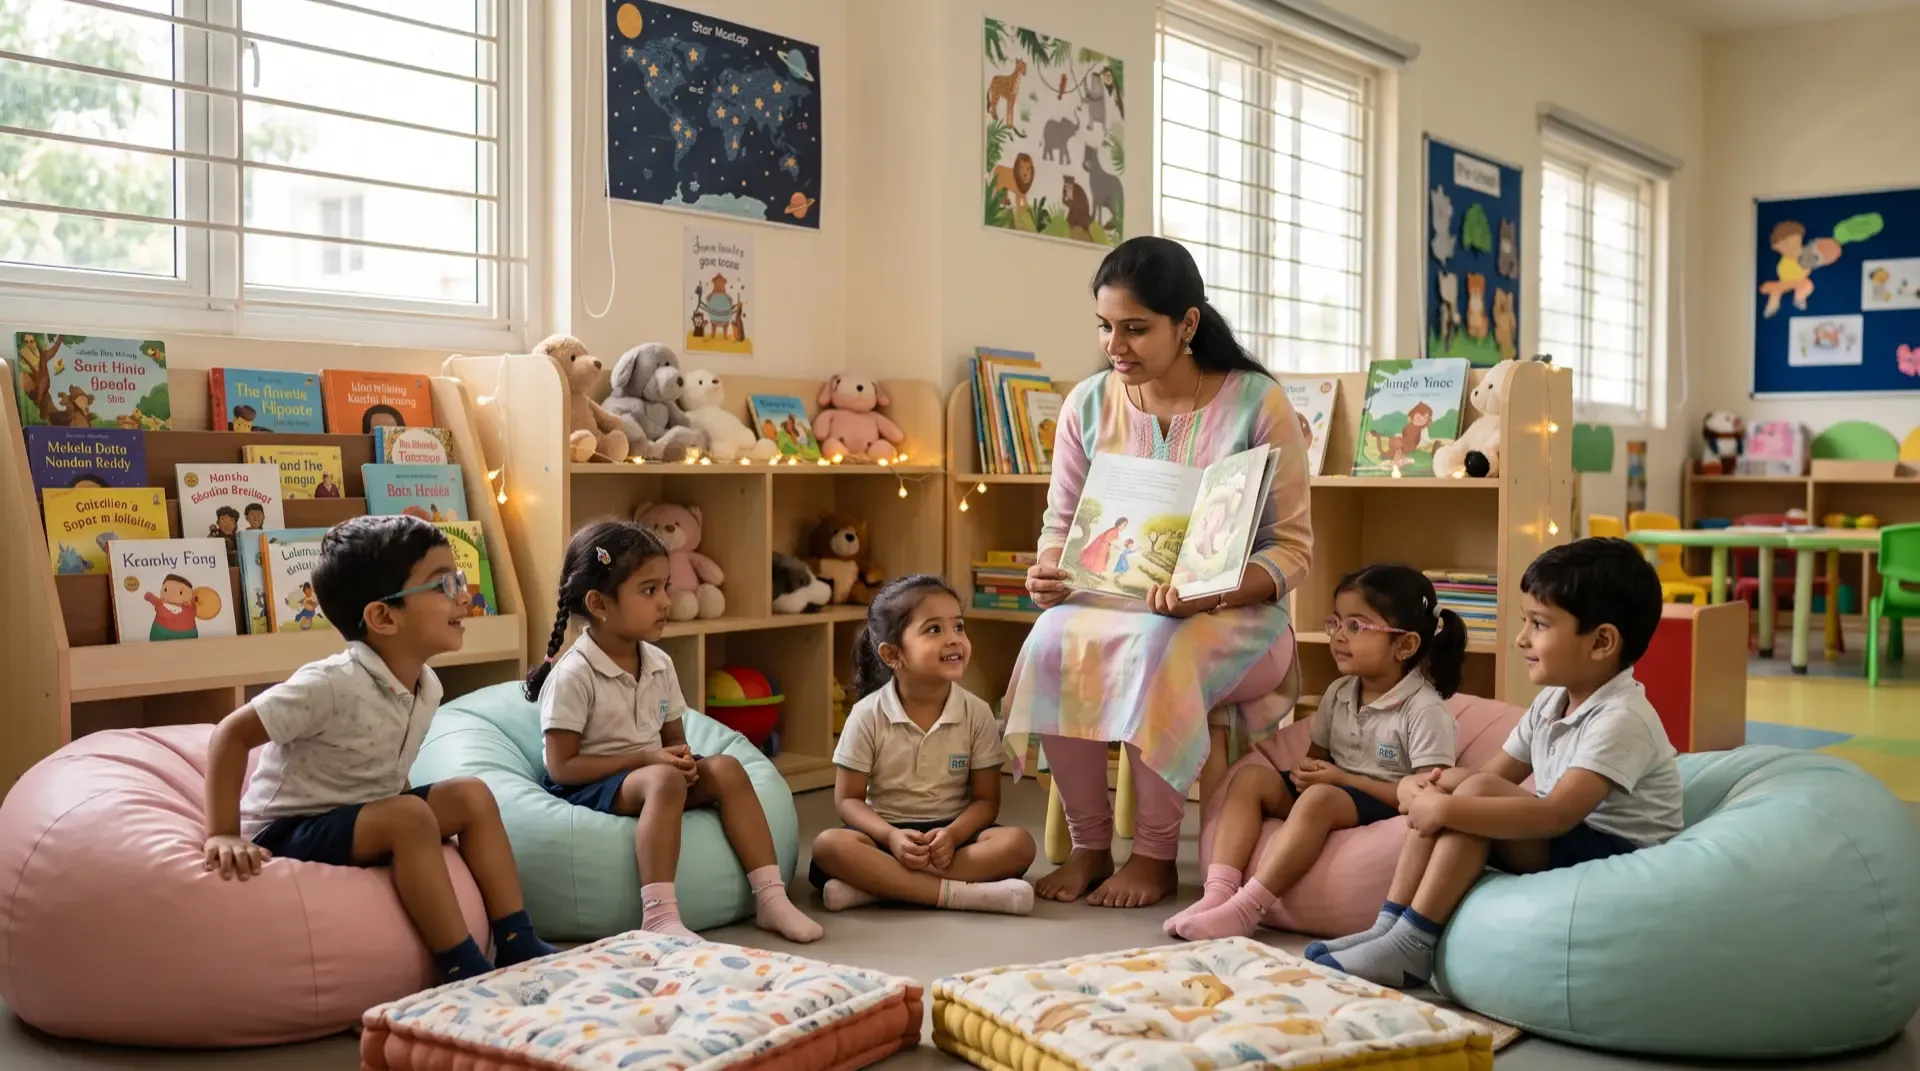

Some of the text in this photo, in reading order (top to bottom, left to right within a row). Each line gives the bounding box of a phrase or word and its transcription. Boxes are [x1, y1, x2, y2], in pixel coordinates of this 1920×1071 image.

[691, 21, 713, 36] Star
[236, 382, 260, 398] The
[45, 455, 131, 473] Nandan Reddy
[280, 460, 301, 471] and
[183, 550, 217, 569] Fong
